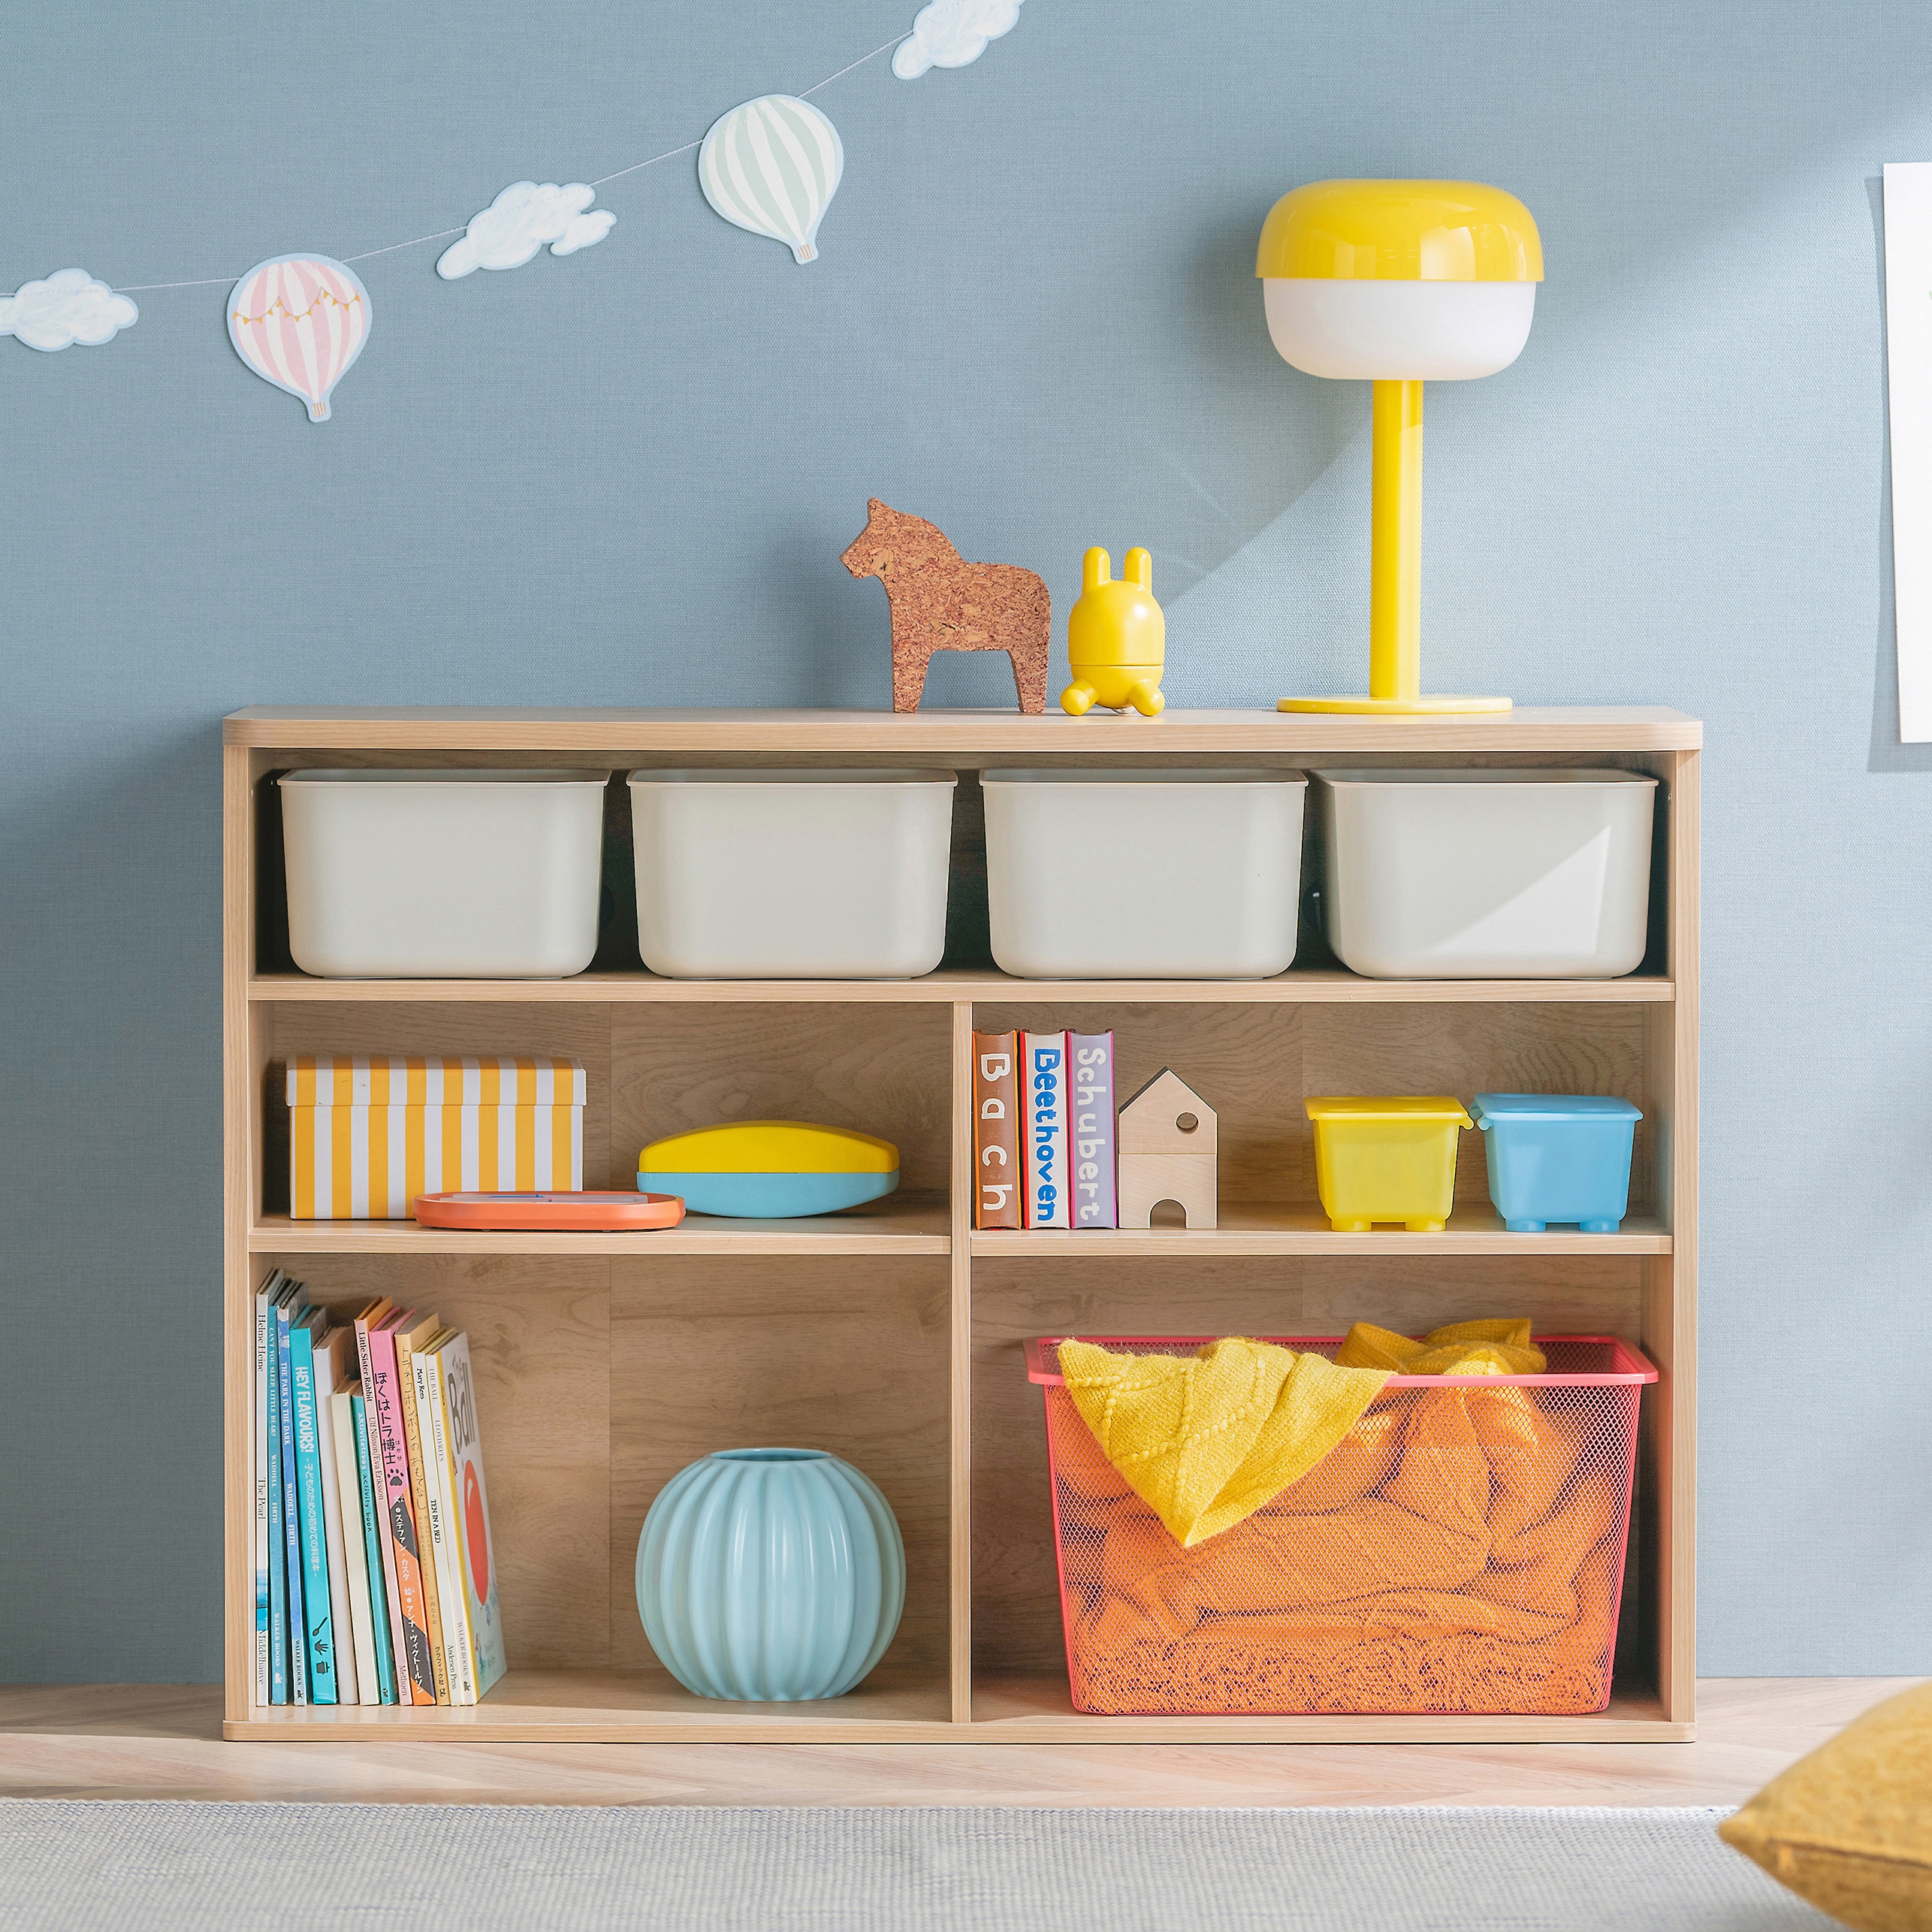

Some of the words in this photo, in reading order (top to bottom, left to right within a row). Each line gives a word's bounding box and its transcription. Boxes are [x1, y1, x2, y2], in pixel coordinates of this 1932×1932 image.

[980, 1053, 1013, 1210] Bach
[1034, 1049, 1061, 1221] Beethoven
[1076, 1048, 1106, 1220] Schubert
[258, 1315, 266, 1343] Helme
[258, 1346, 266, 1372] Heine
[361, 1353, 369, 1375] Sister
[295, 1366, 309, 1389] HEY
[364, 1377, 373, 1402] Rabbit
[282, 1399, 288, 1407] IN
[448, 1363, 475, 1454] Ball
[297, 1390, 314, 1453] FLAVOURS!
[258, 1478, 266, 1496] The
[363, 1474, 371, 1508] activity
[376, 1471, 384, 1500] Eriksson
[258, 1498, 266, 1520] Pearl
[457, 1622, 466, 1650] WALKER
[258, 1629, 266, 1684] Middelhauve
[460, 1650, 469, 1676] BOOKS
[399, 1665, 408, 1696] Methuen
